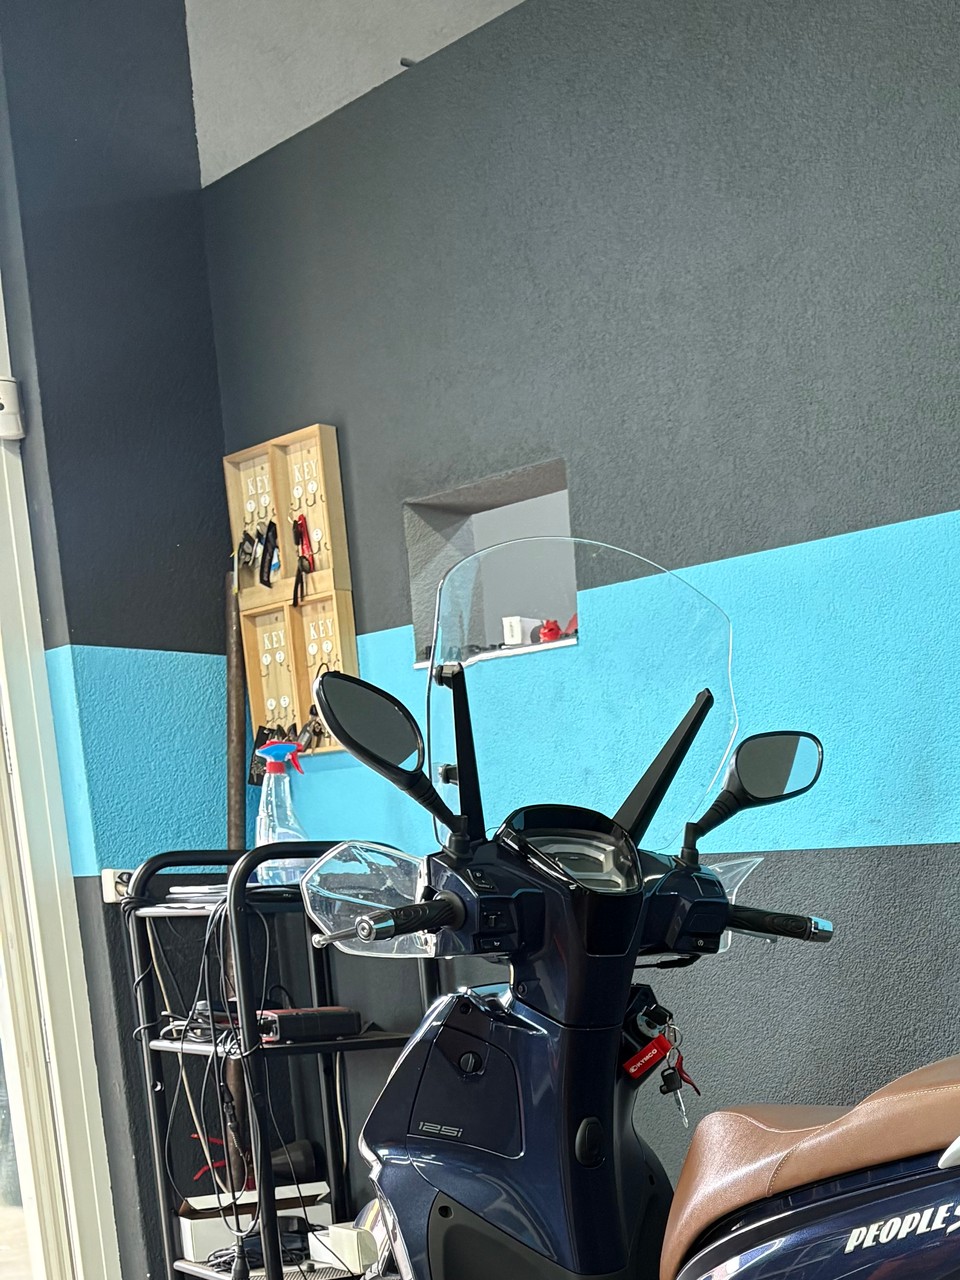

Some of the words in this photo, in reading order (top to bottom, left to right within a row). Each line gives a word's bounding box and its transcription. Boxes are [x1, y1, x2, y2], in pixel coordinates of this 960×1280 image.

[294, 459, 318, 482] KEY
[247, 474, 271, 496] KEY
[263, 629, 286, 650] KEY
[309, 618, 333, 640] KEY
[635, 1048, 658, 1069] KYMCO
[418, 1121, 464, 1138] 125i
